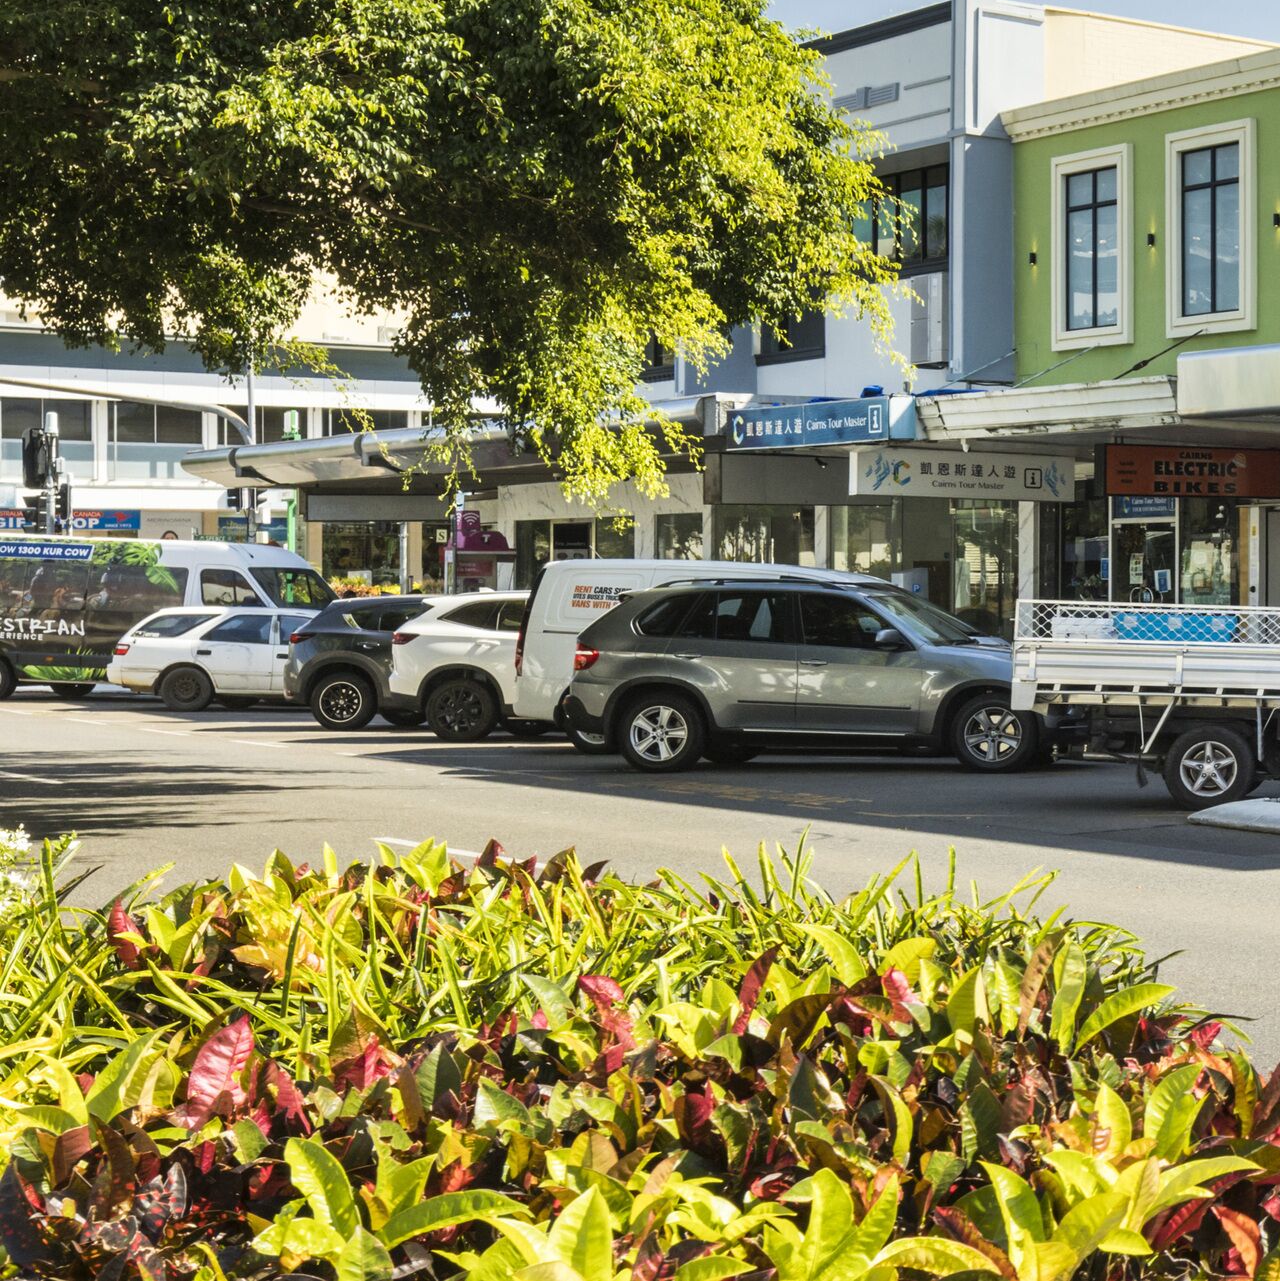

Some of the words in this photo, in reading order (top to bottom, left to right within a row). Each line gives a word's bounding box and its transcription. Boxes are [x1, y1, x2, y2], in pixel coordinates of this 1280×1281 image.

[806, 420, 826, 431] Cairns
[828, 418, 842, 429] Tour
[844, 416, 867, 427] Master
[1179, 452, 1212, 460] CAIRNS
[1154, 461, 1238, 477] ELECTRIC
[932, 480, 957, 489] Cairns
[959, 481, 976, 489] Tour
[978, 481, 1005, 490] Master
[1154, 481, 1237, 494] BIKES
[18, 546, 41, 554] 1300
[43, 547, 63, 556] KUR
[64, 547, 89, 557] COW
[574, 585, 593, 594] RENT
[594, 586, 613, 595] CARS
[571, 600, 590, 608] VANS
[592, 601, 612, 609] WITH
[0, 617, 85, 636] STRIAN
